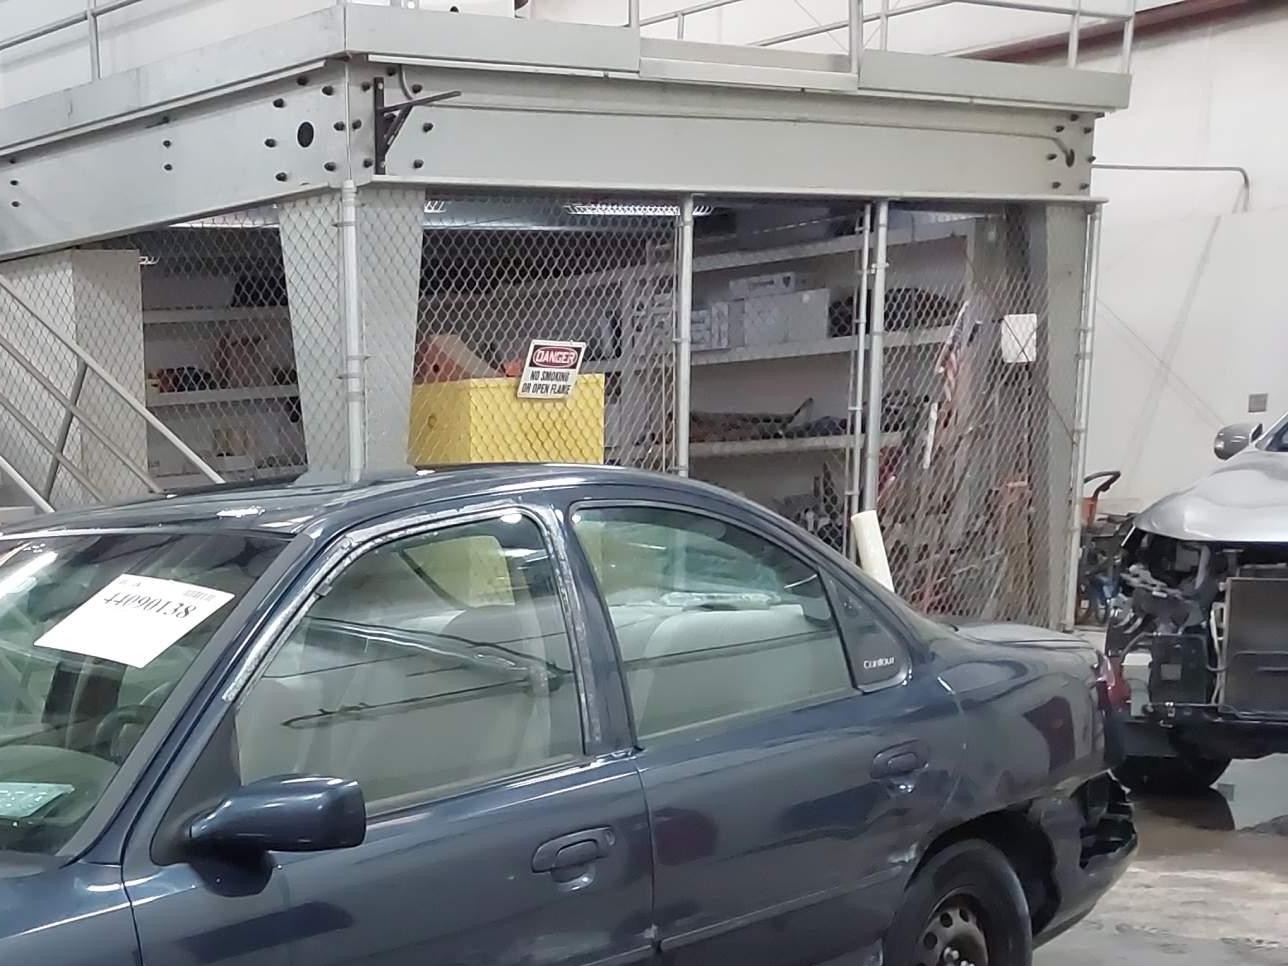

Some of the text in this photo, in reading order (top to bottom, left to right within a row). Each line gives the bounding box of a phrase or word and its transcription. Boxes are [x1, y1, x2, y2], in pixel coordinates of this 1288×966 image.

[535, 350, 576, 364] DANGER
[530, 370, 570, 382] NO SMOKING
[521, 383, 571, 395] OR OPEN FLAME
[103, 592, 197, 619] 44090138
[863, 656, 895, 669] Contour
